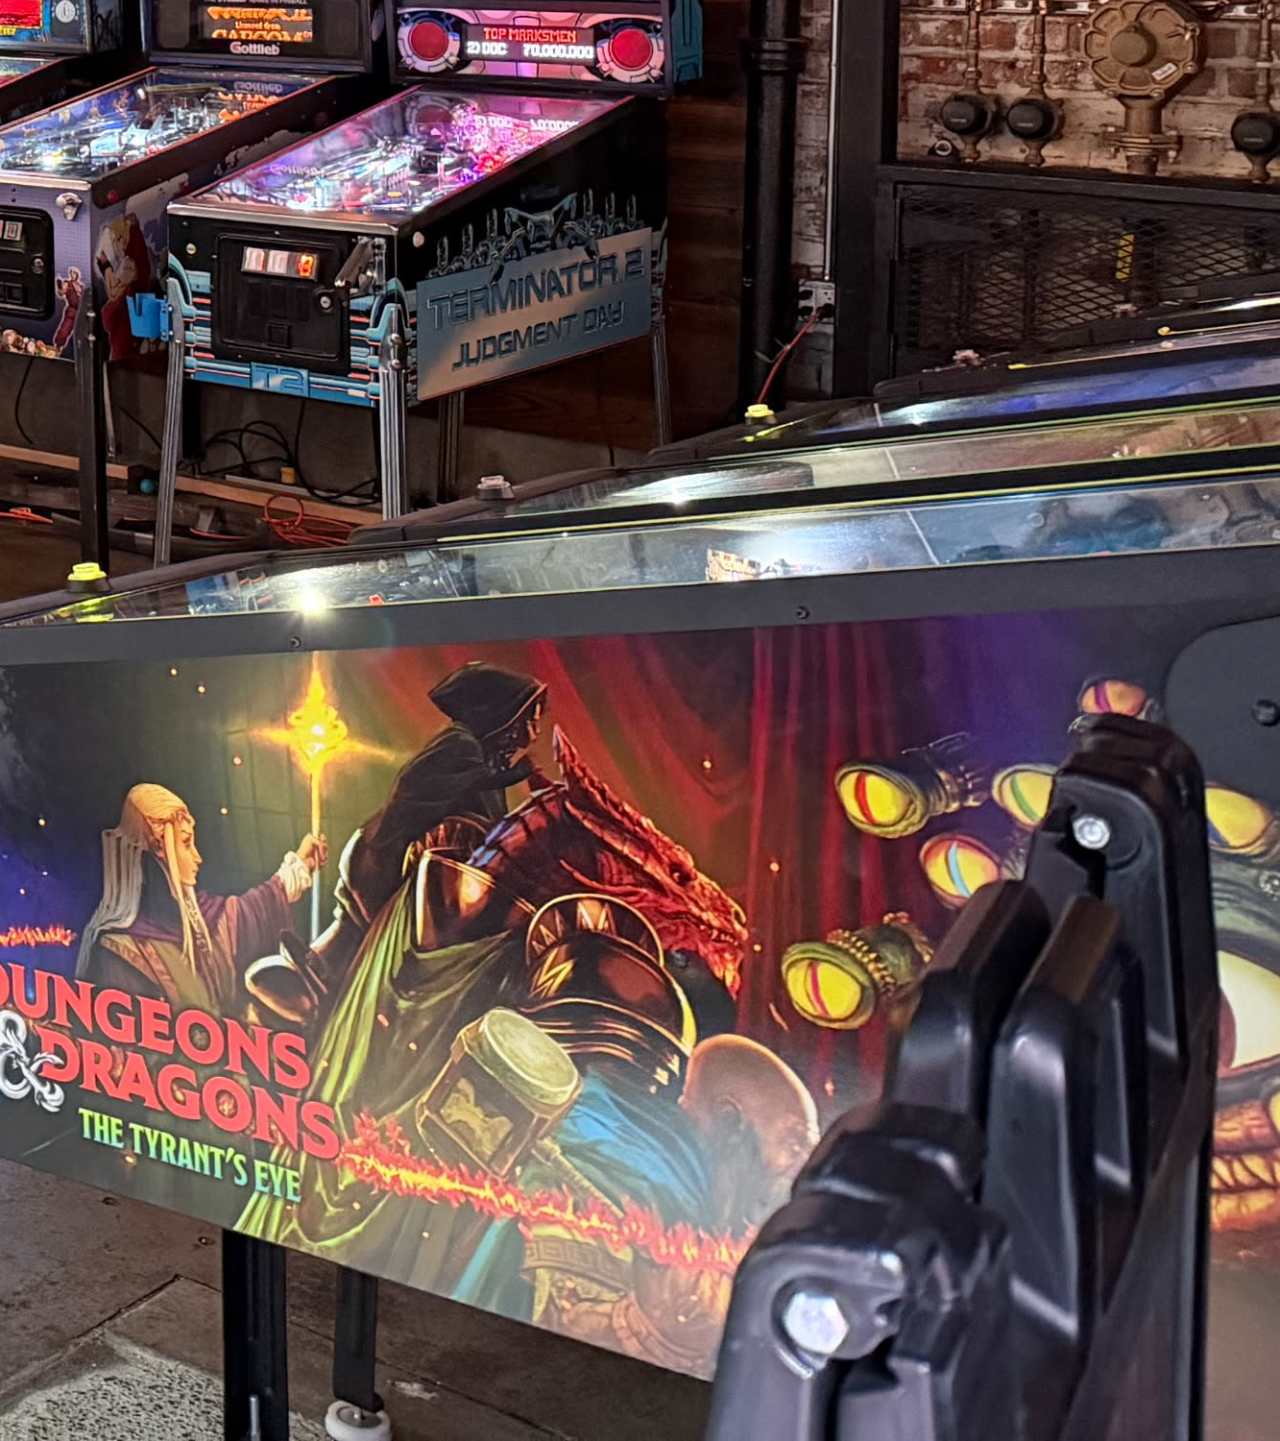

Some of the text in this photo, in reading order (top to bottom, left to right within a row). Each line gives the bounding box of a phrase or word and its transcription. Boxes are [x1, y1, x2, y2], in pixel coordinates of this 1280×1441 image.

[230, 42, 280, 55] Gottlieb
[484, 28, 577, 43] TOP MARKSMEN
[427, 248, 645, 330] TERMINATOR 2
[451, 301, 624, 372] JUDGMENT DAY
[254, 364, 306, 394] T2
[32, 1024, 340, 1159] DRAGONS
[77, 1108, 302, 1203] THE TYRANT'S EYE
